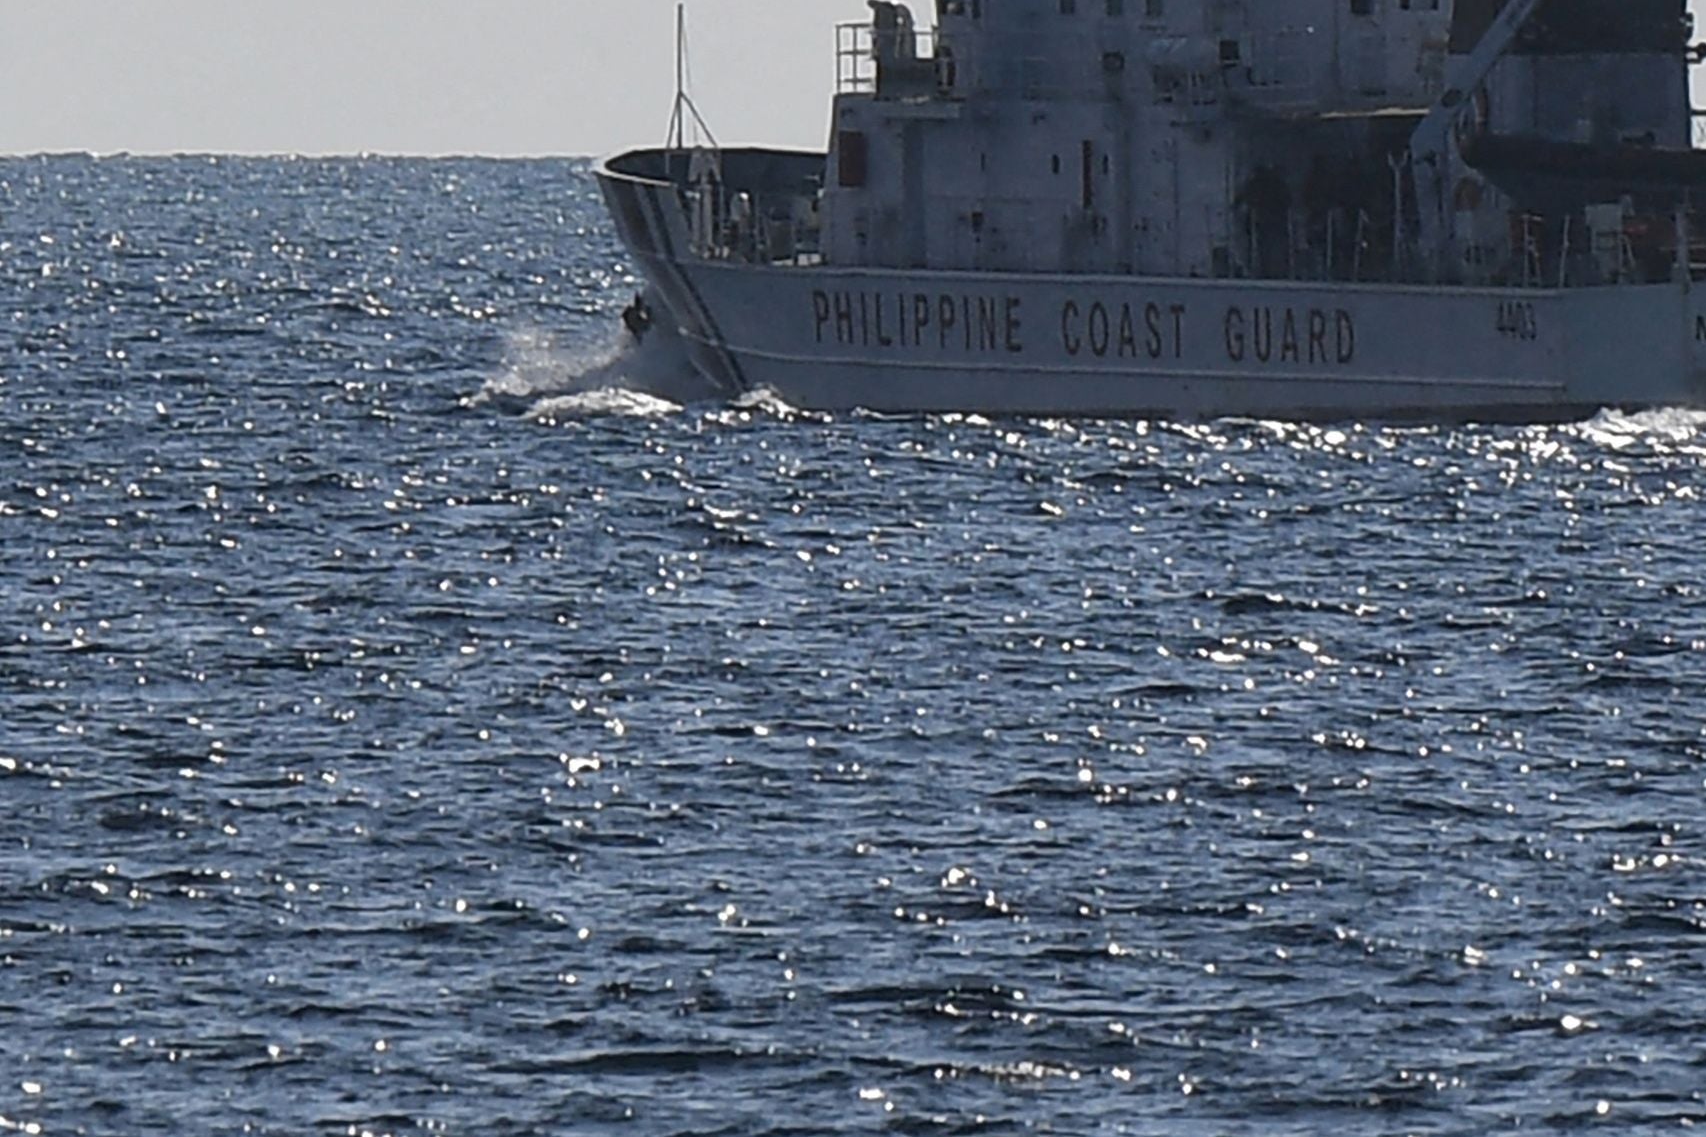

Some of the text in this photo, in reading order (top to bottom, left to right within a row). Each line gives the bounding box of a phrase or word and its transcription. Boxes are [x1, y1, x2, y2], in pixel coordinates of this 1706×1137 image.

[812, 290, 1355, 363] PHILIPPINE COAST GUARD
